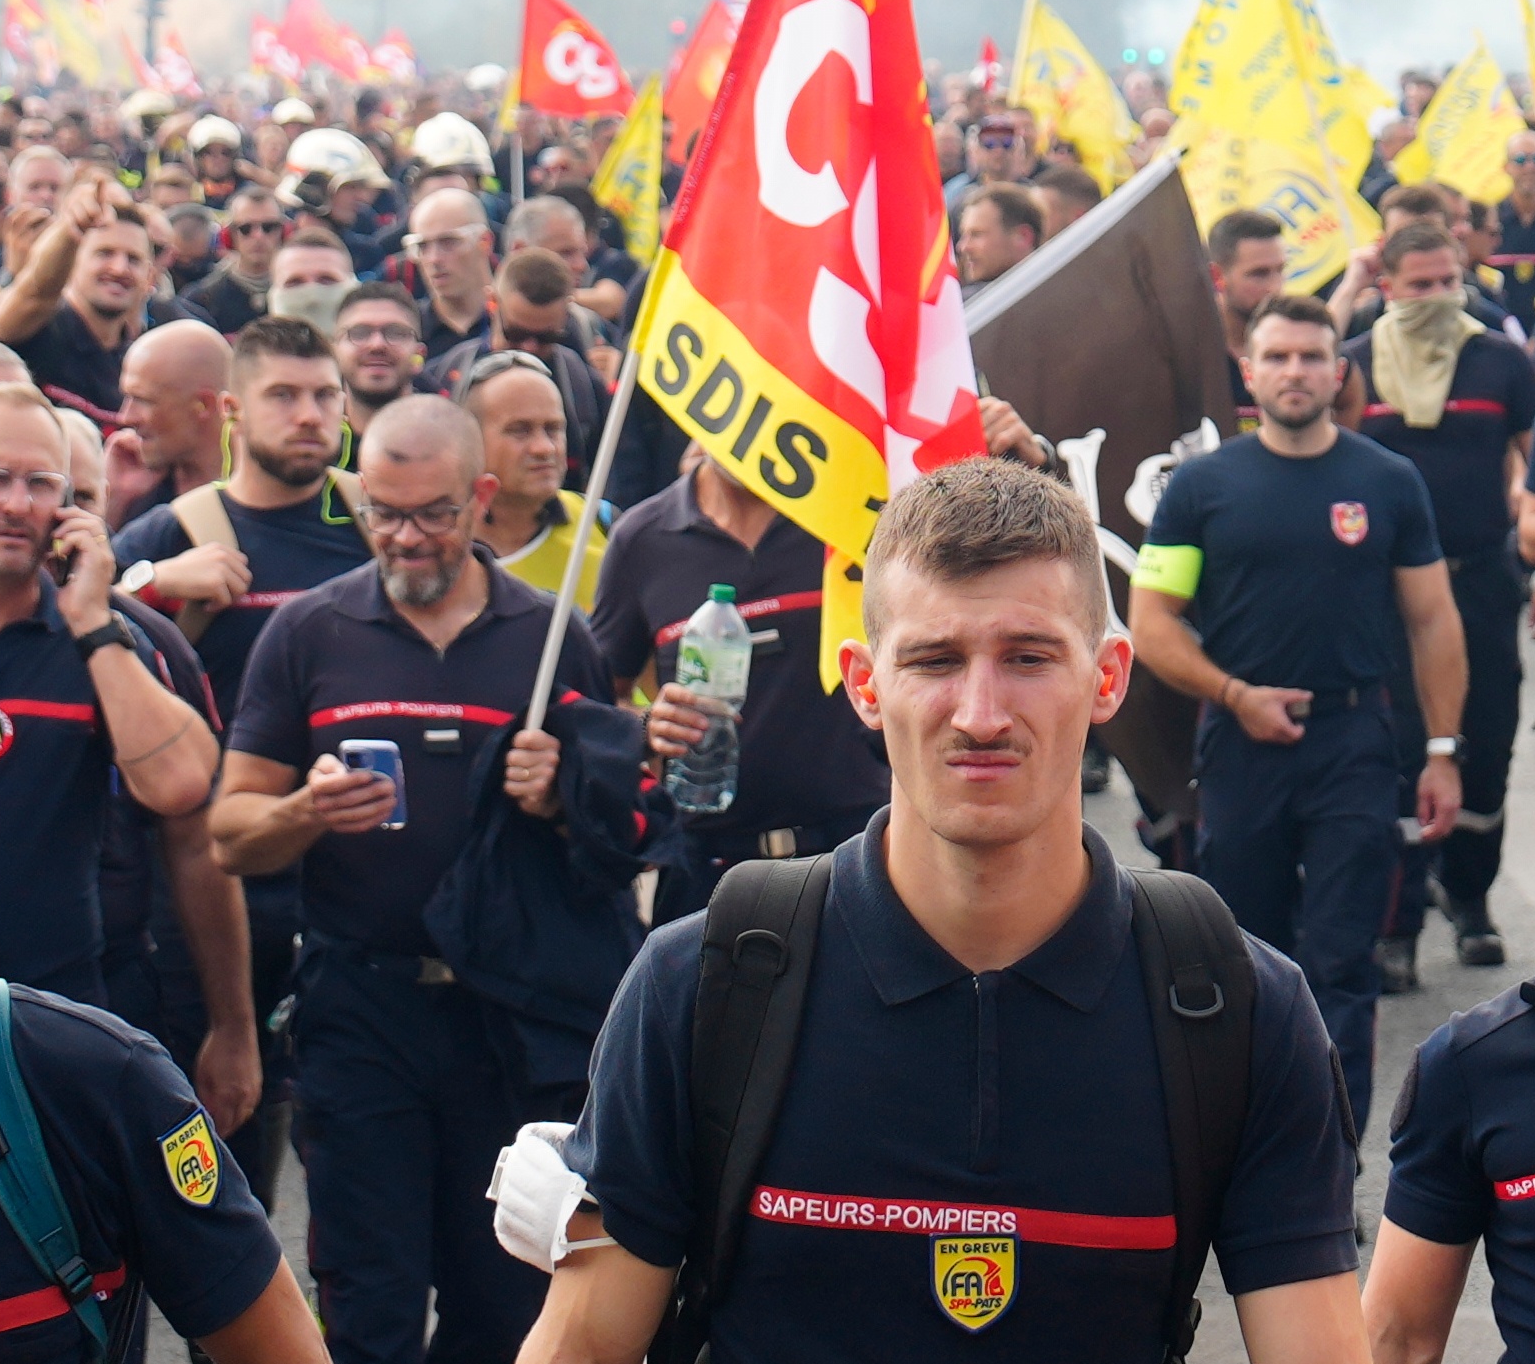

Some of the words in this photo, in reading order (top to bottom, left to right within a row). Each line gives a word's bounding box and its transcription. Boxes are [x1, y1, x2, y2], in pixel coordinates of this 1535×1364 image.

[653, 322, 830, 499] SDIS
[759, 1191, 1017, 1234] SAPEURS-POMPIERS
[940, 1243, 958, 1254] EN
[963, 1242, 1009, 1254] GREVE
[948, 1297, 1003, 1311] SPP-PATS
